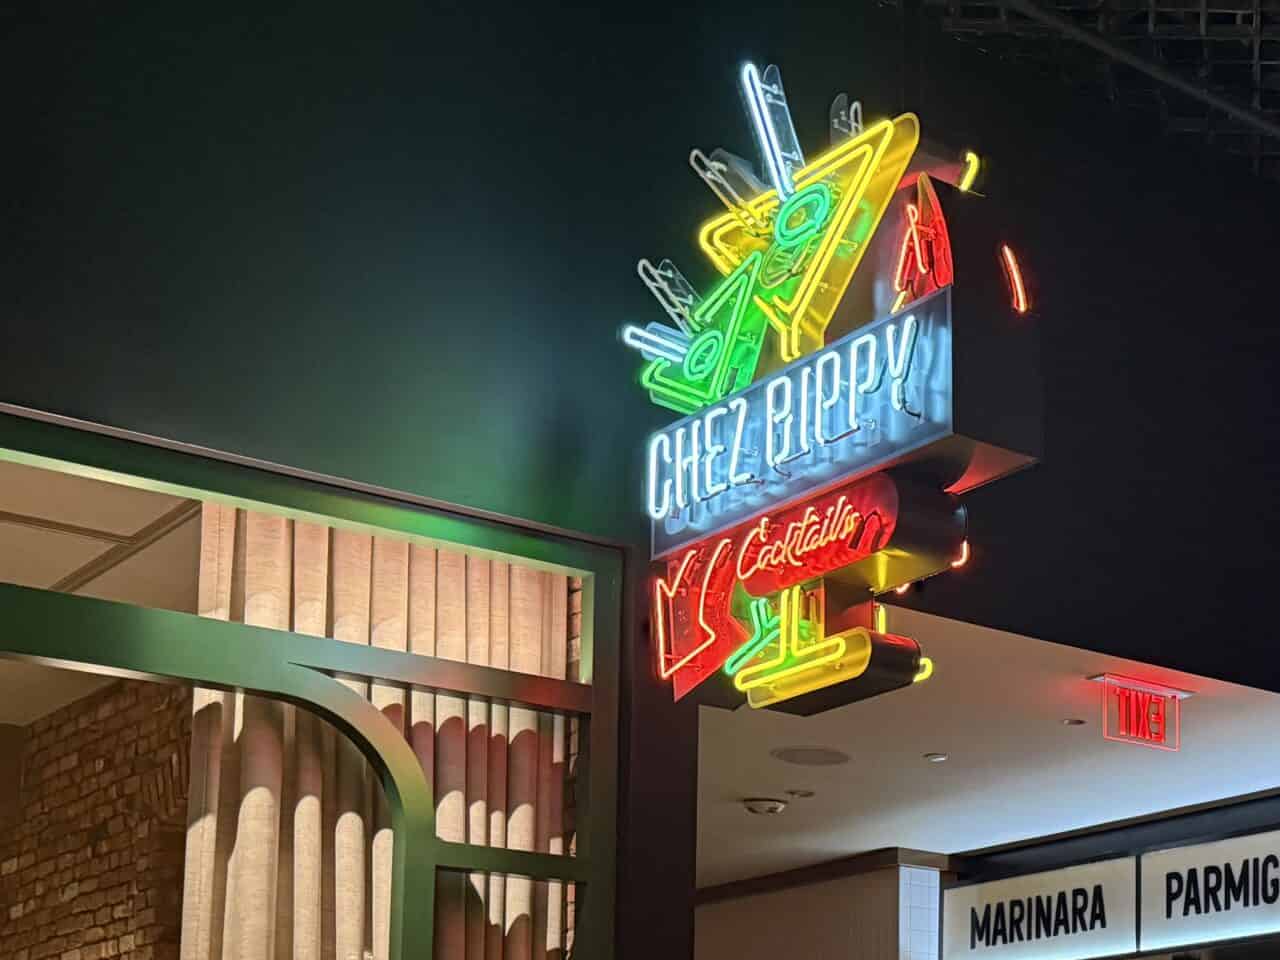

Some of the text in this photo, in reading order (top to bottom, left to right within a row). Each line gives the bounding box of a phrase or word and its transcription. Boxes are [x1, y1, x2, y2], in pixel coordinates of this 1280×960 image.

[648, 314, 918, 520] CHEZ BIPPY
[735, 495, 862, 581] Cocktails
[969, 884, 1108, 950] MARINARA
